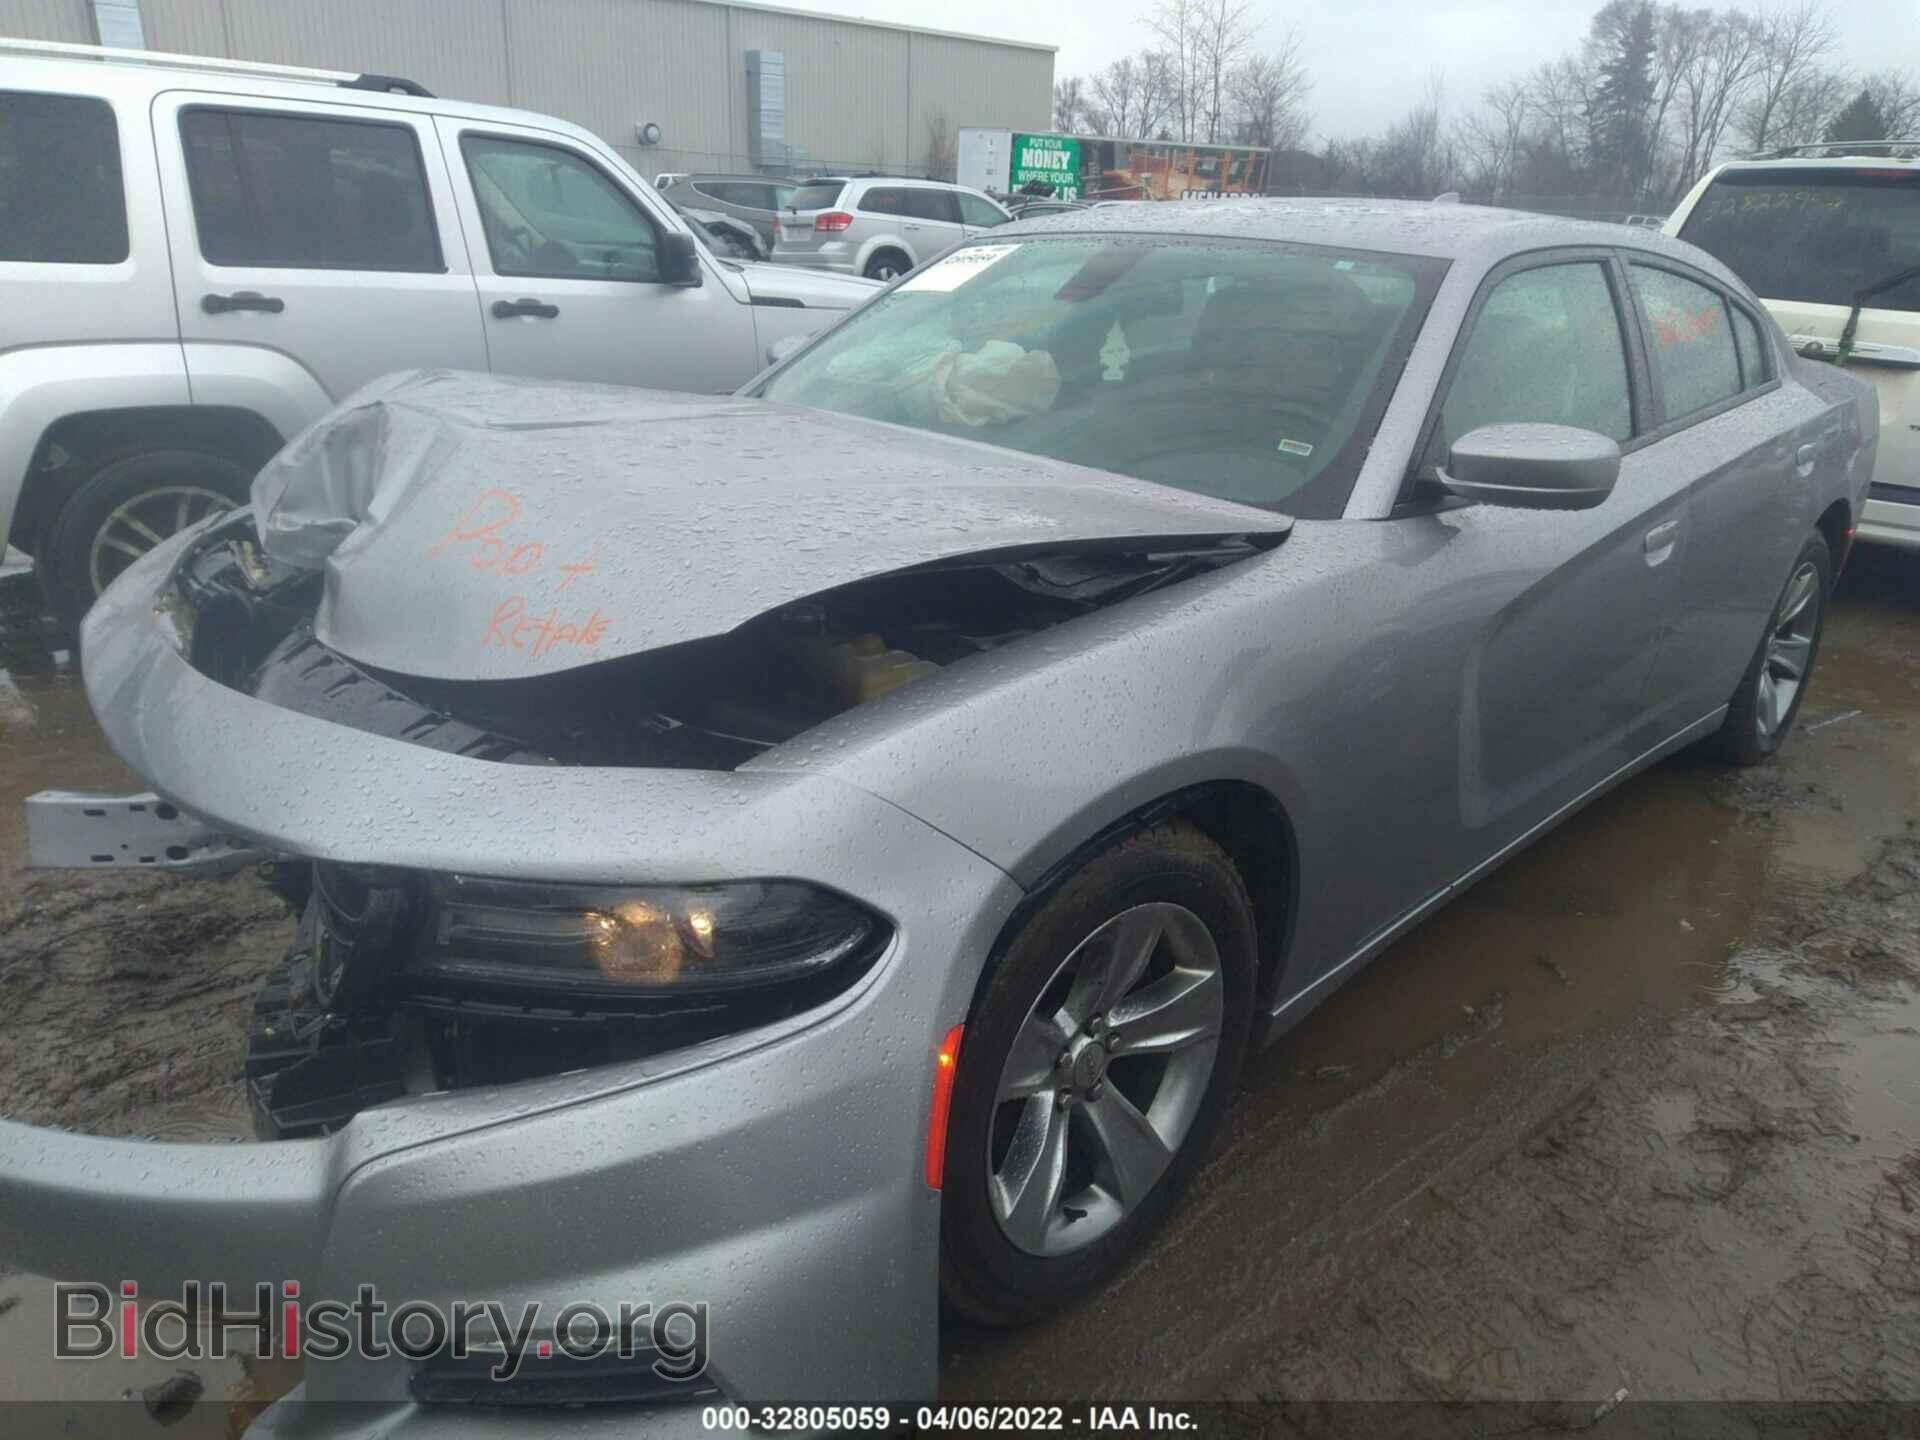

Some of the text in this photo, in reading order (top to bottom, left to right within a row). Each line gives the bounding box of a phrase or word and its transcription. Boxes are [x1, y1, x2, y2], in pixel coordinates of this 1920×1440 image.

[1021, 147, 1071, 170] MONEY
[1017, 169, 1074, 184] WHERE YOUR
